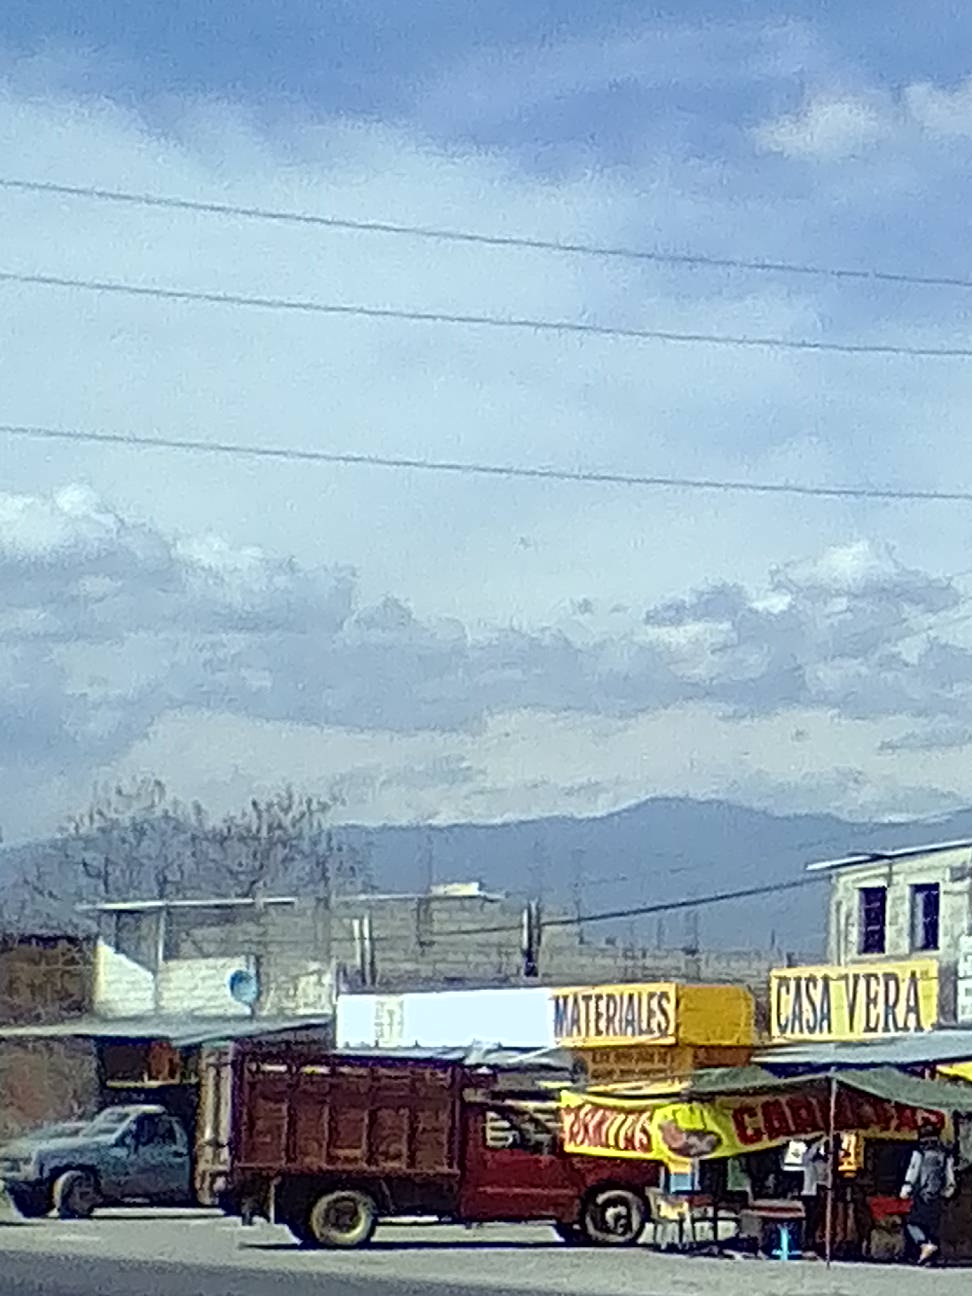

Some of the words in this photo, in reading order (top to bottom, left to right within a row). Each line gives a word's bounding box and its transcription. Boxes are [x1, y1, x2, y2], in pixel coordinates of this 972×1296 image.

[553, 991, 671, 1038] MATERIALES
[776, 974, 832, 1034] CASA
[844, 970, 924, 1033] VERA
